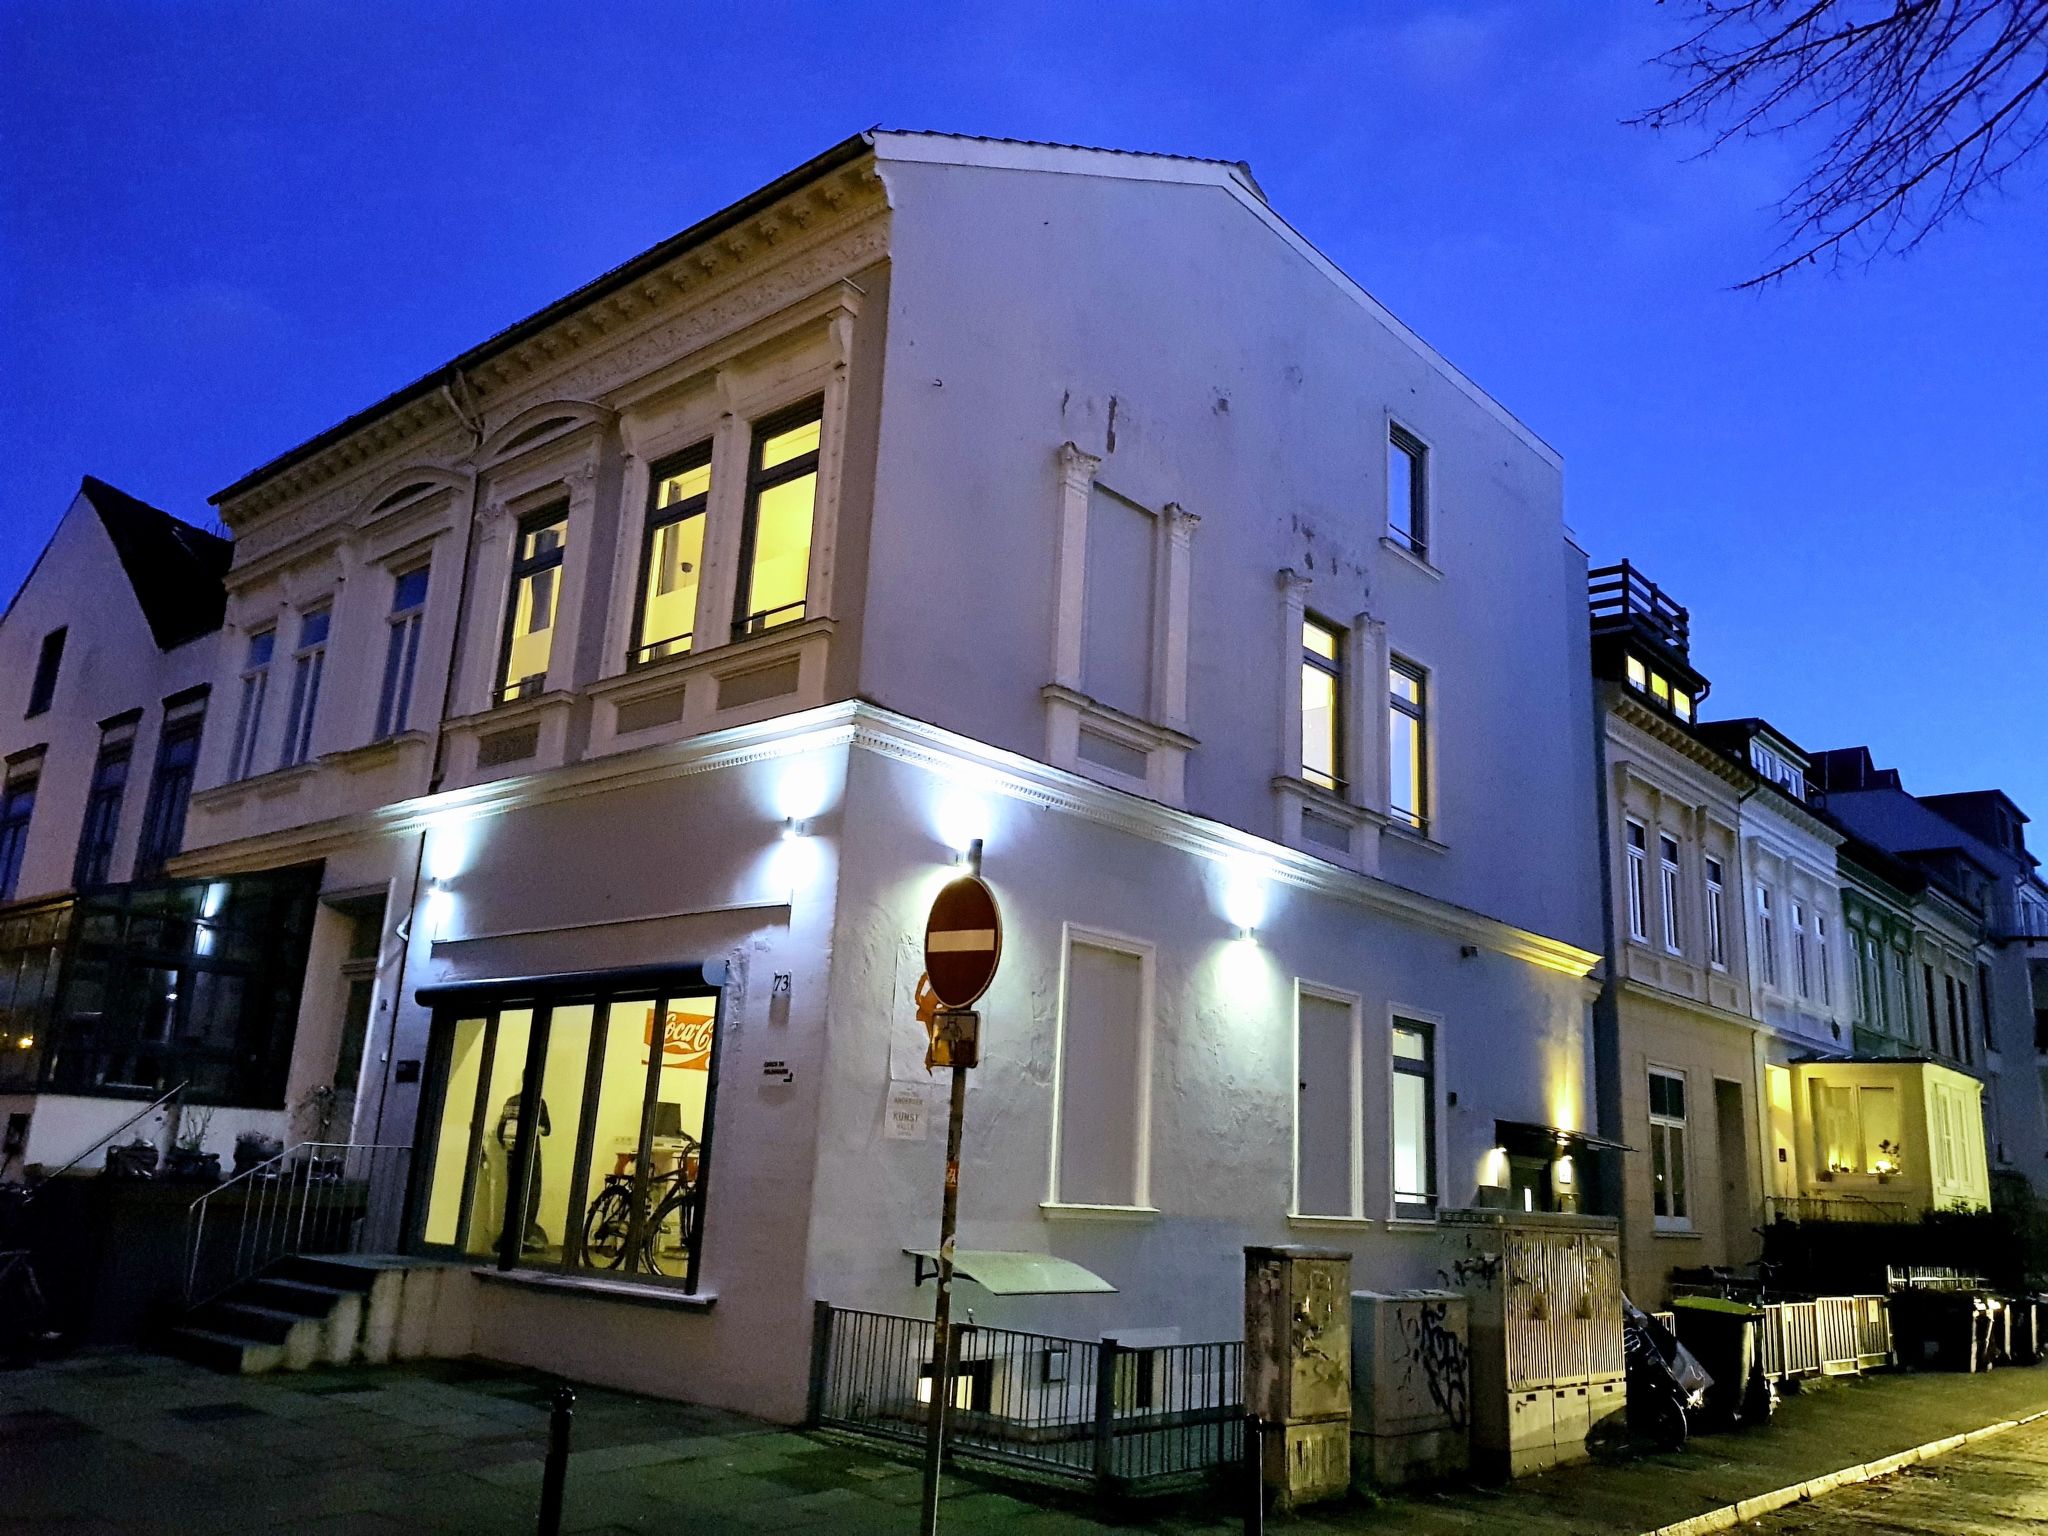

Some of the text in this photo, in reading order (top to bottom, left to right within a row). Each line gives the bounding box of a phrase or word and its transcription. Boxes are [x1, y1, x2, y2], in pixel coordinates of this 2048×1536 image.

[774, 974, 789, 992] 73
[664, 1012, 714, 1053] oca-C
[893, 1111, 920, 1122] KUNST
